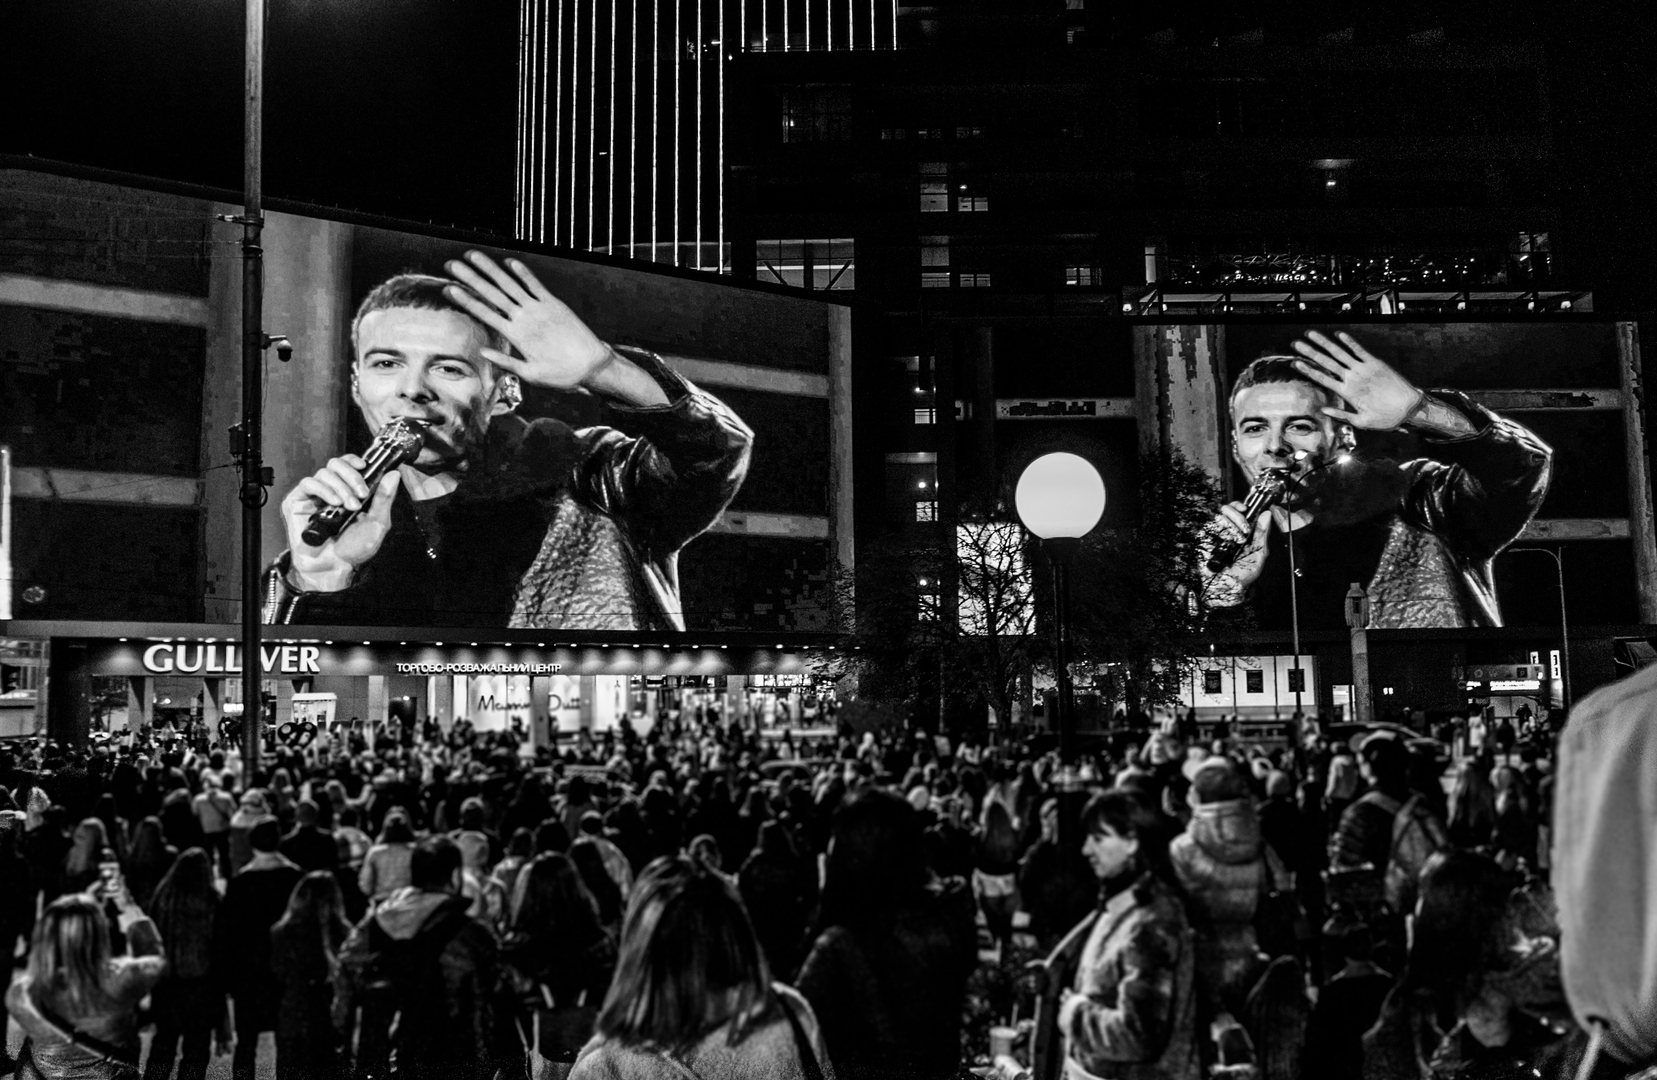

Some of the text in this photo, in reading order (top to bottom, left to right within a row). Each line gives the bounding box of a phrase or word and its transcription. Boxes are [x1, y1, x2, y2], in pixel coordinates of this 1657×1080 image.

[143, 643, 320, 672] GULLVER
[396, 662, 562, 674] ТОРГОВО-РОЗВАЖАЛЬНИЙ ЦЕНТР
